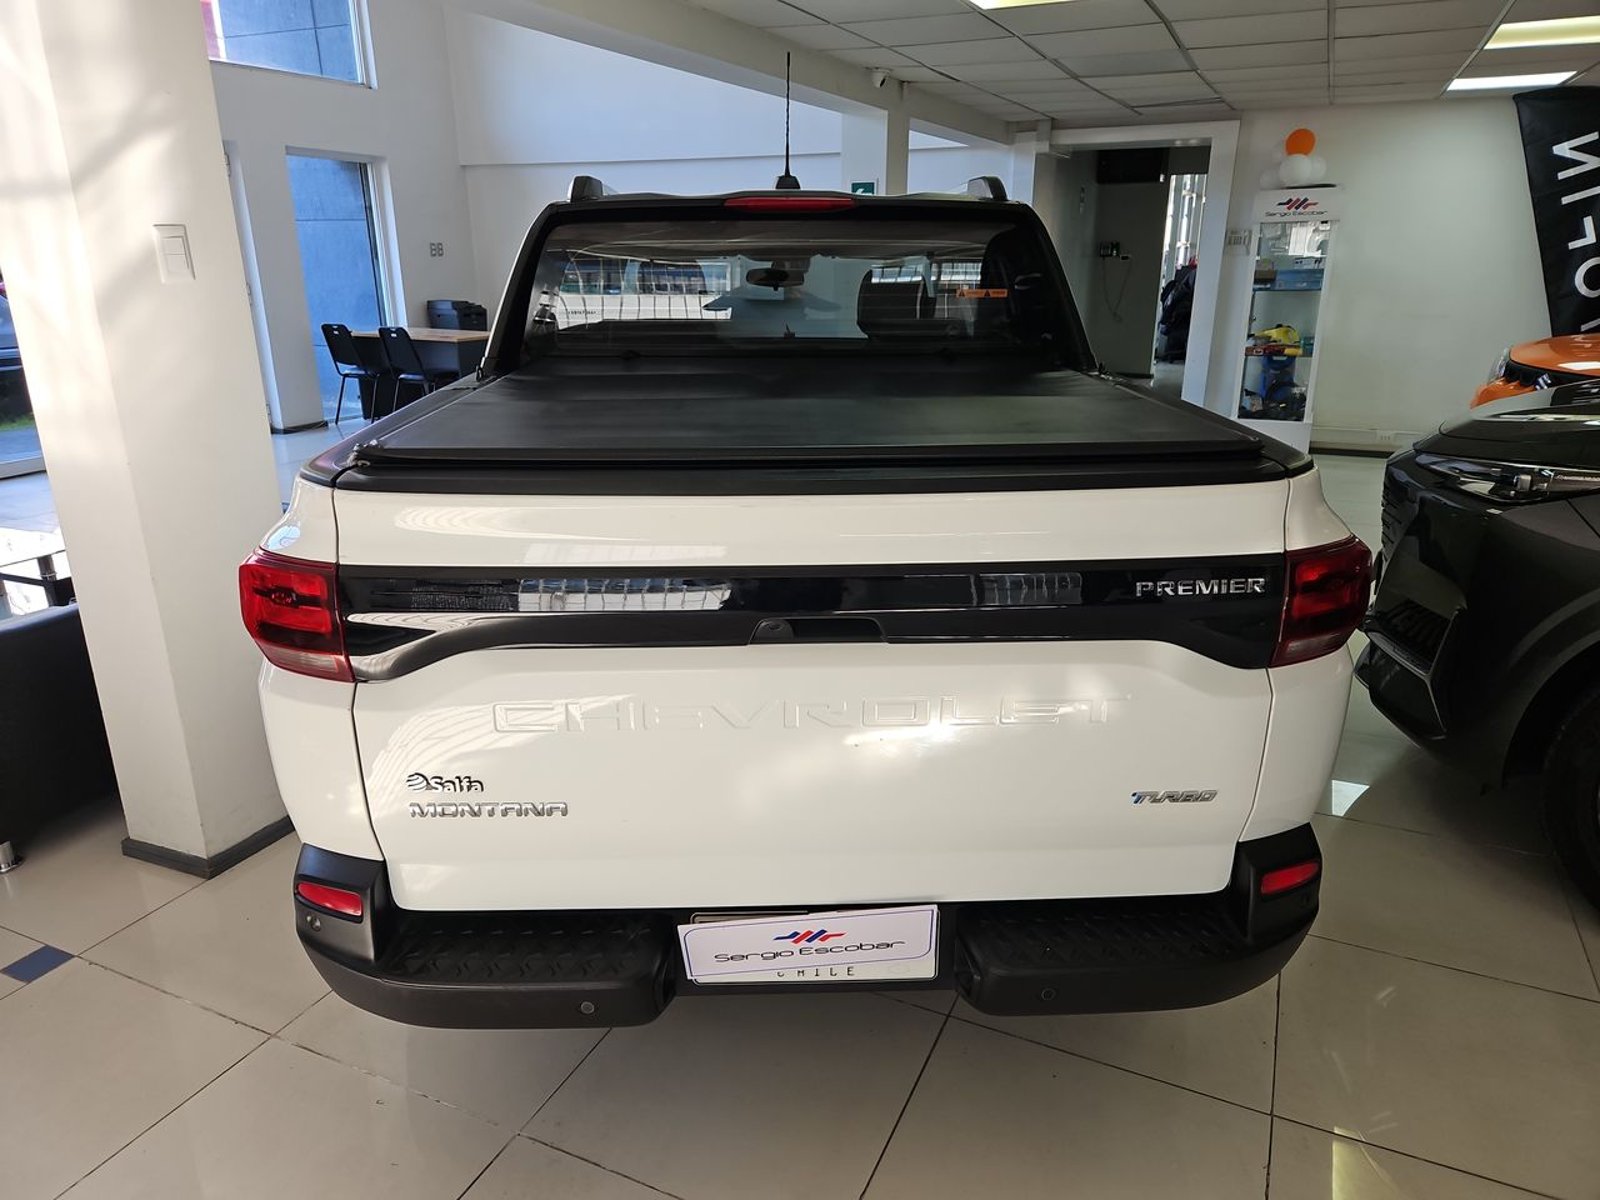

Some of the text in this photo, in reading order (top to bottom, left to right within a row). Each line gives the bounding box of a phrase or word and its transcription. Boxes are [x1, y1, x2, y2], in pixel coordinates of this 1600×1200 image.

[1135, 578, 1266, 597] PREMIER
[492, 695, 1131, 733] CHEVROLET
[430, 775, 484, 793] Salfa
[1131, 790, 1218, 804] TURBO
[408, 802, 569, 818] MONTANA
[714, 940, 906, 962] Sergio Escobar
